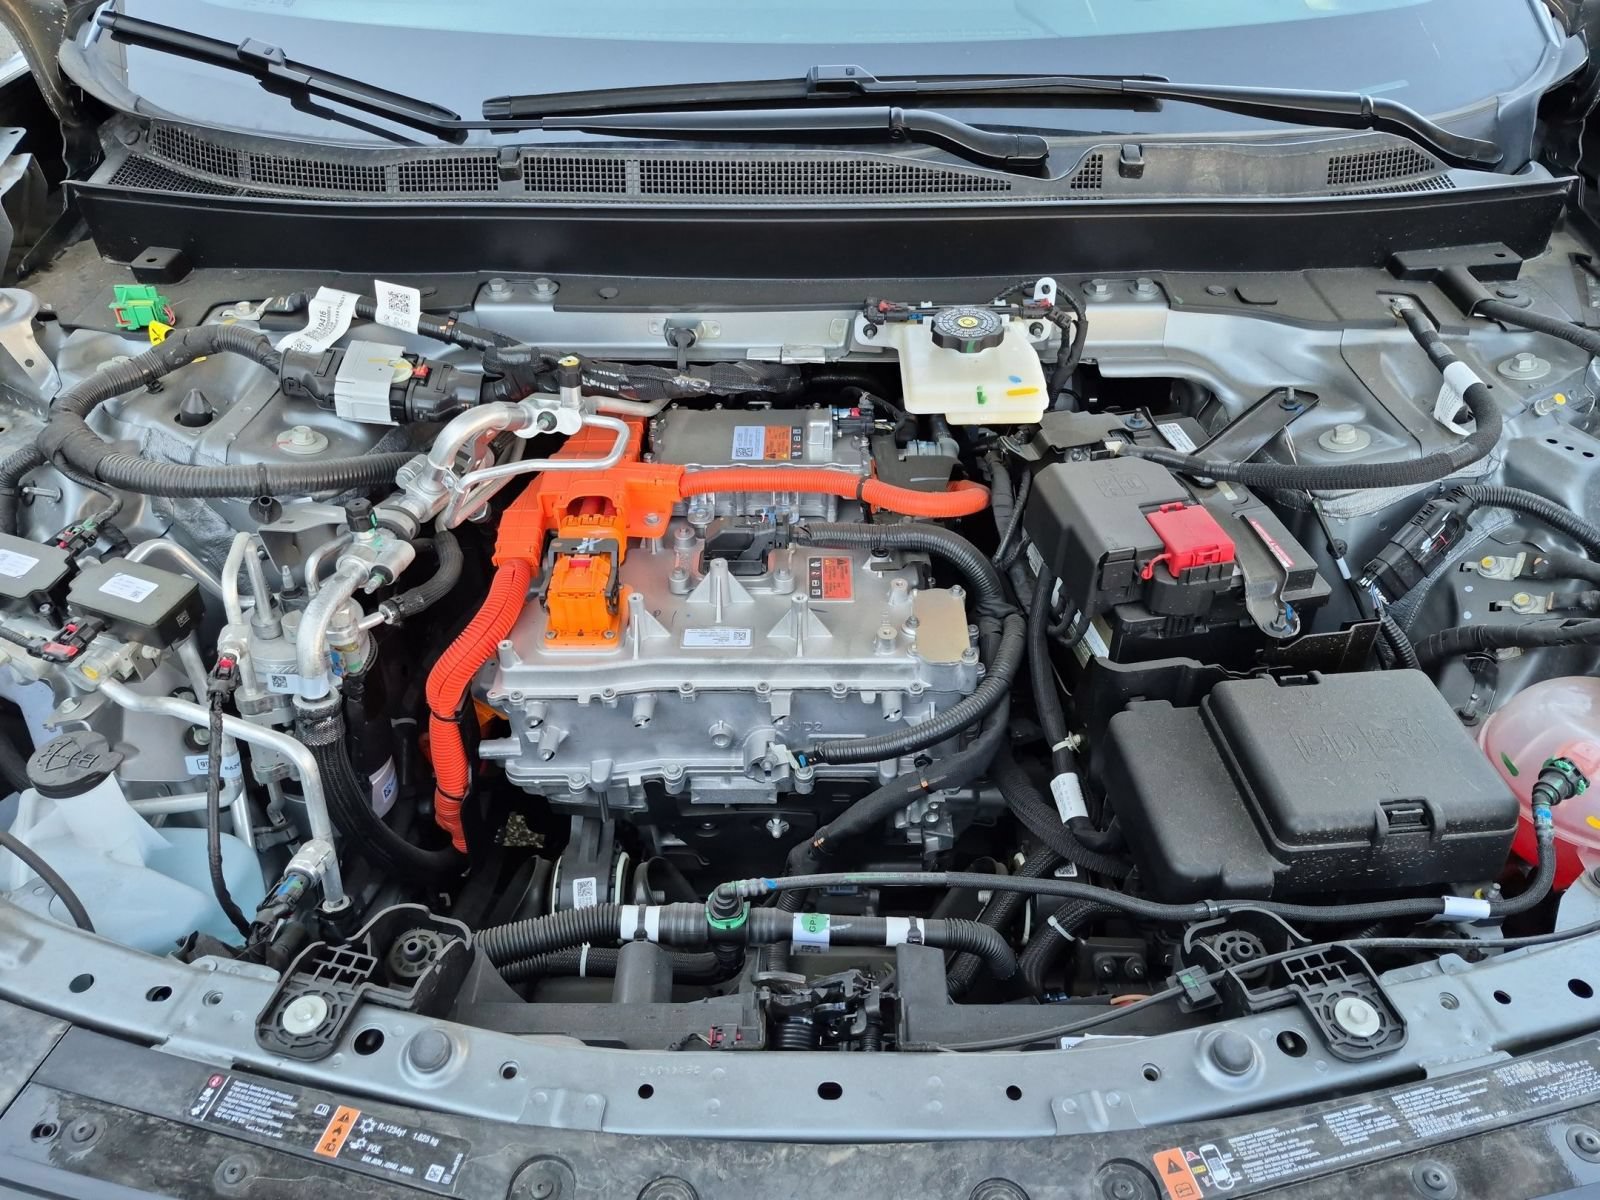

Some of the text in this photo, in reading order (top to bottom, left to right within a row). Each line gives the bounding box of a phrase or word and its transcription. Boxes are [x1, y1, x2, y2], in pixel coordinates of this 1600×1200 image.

[377, 1123, 407, 1137] R-1234yf
[430, 1137, 439, 1147] kg
[367, 1144, 381, 1154] POE
